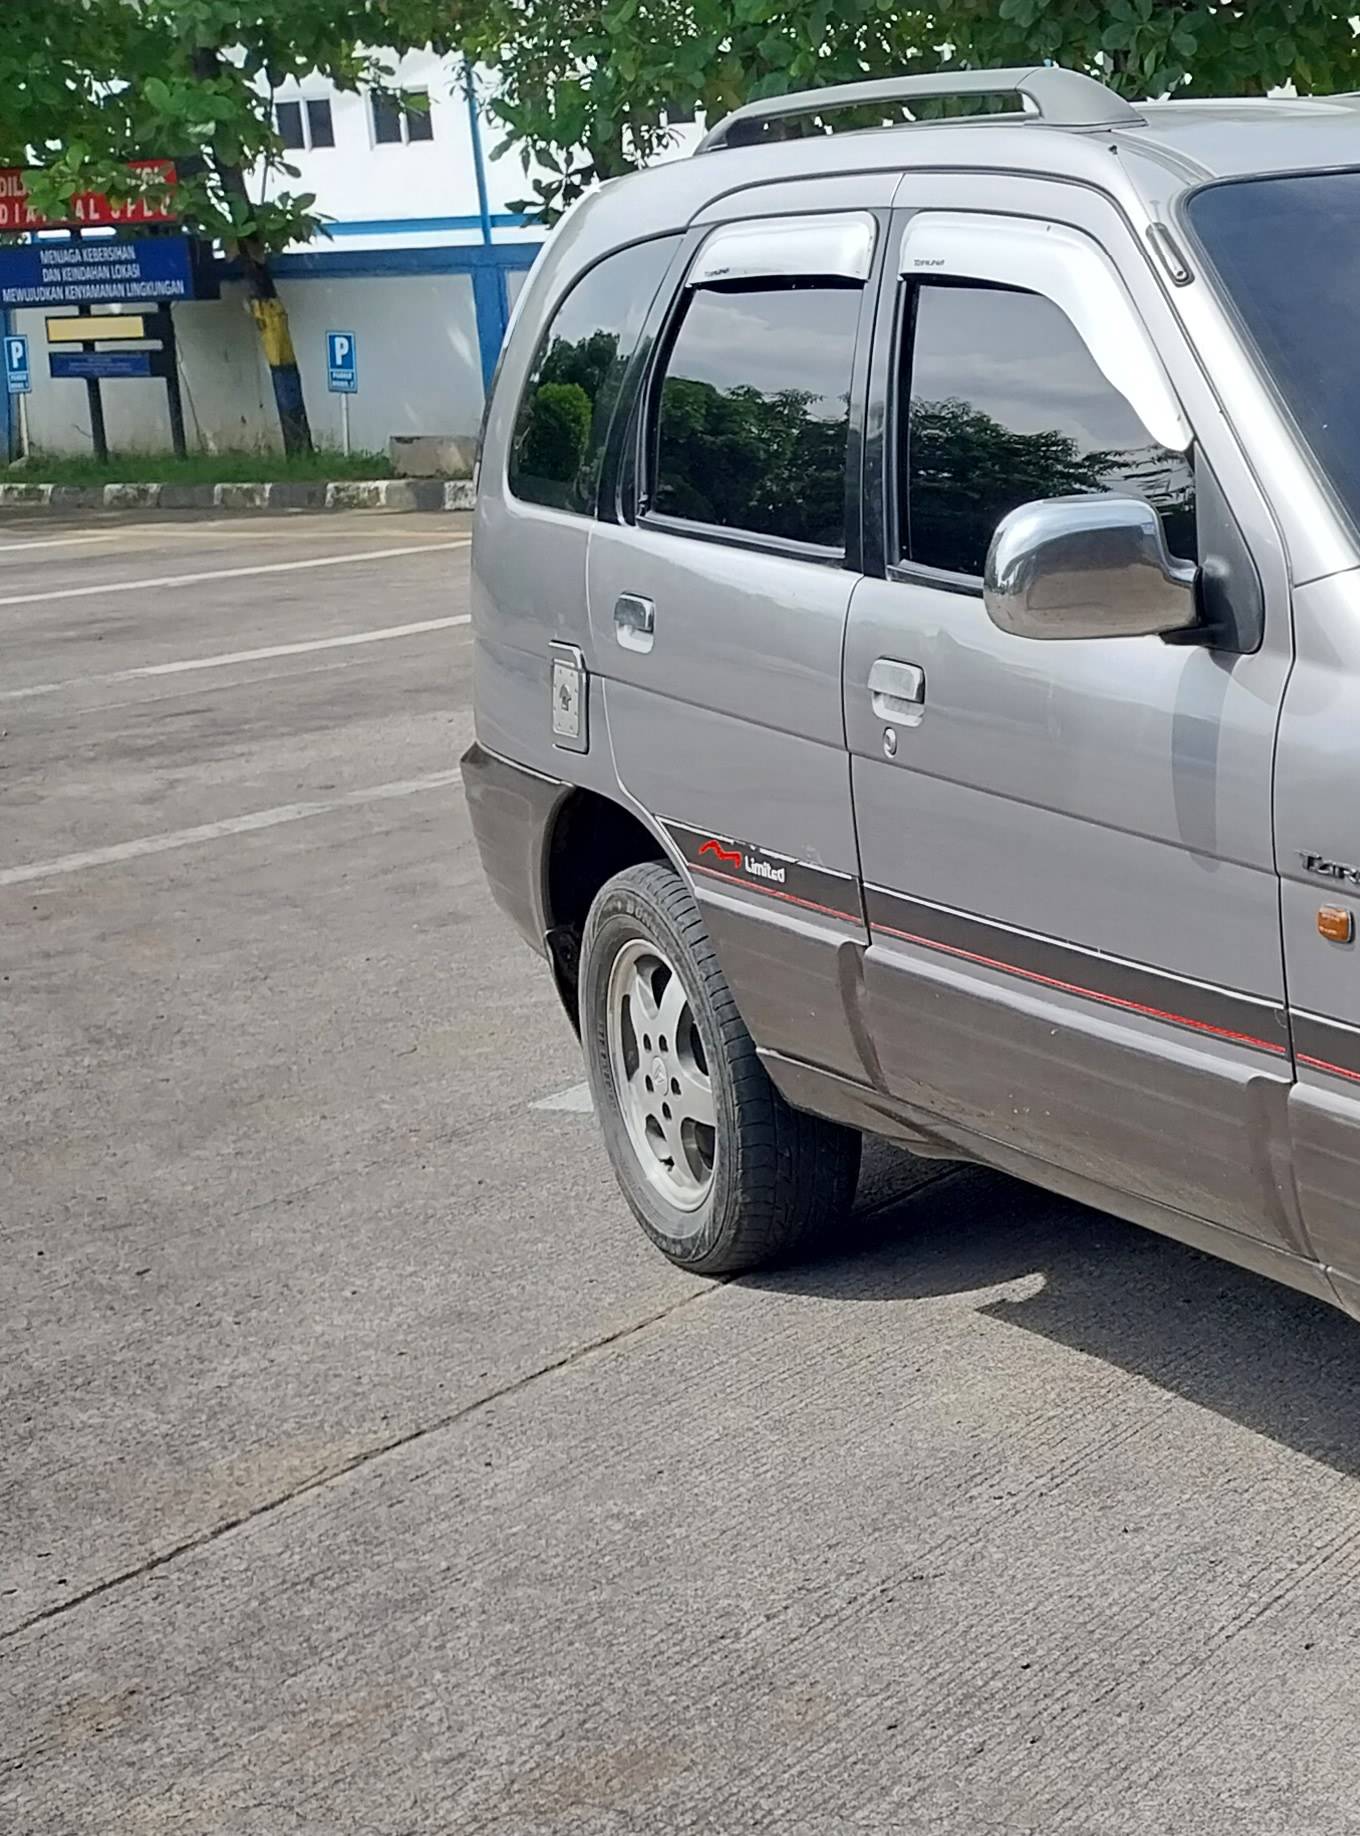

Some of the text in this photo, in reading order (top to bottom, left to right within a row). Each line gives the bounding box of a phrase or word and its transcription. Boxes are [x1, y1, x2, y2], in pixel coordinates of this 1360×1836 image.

[26, 197, 100, 223] AAL
[40, 246, 136, 264] MENJAGA KEBERSIHAN
[42, 264, 140, 282] DAN KEINDAHAN LOKASI
[2, 280, 185, 302] MEWUJUDKAN KENYAMANAN LINGKUNGAN
[11, 341, 24, 368] P
[335, 337, 349, 365] P
[744, 855, 785, 883] Limited
